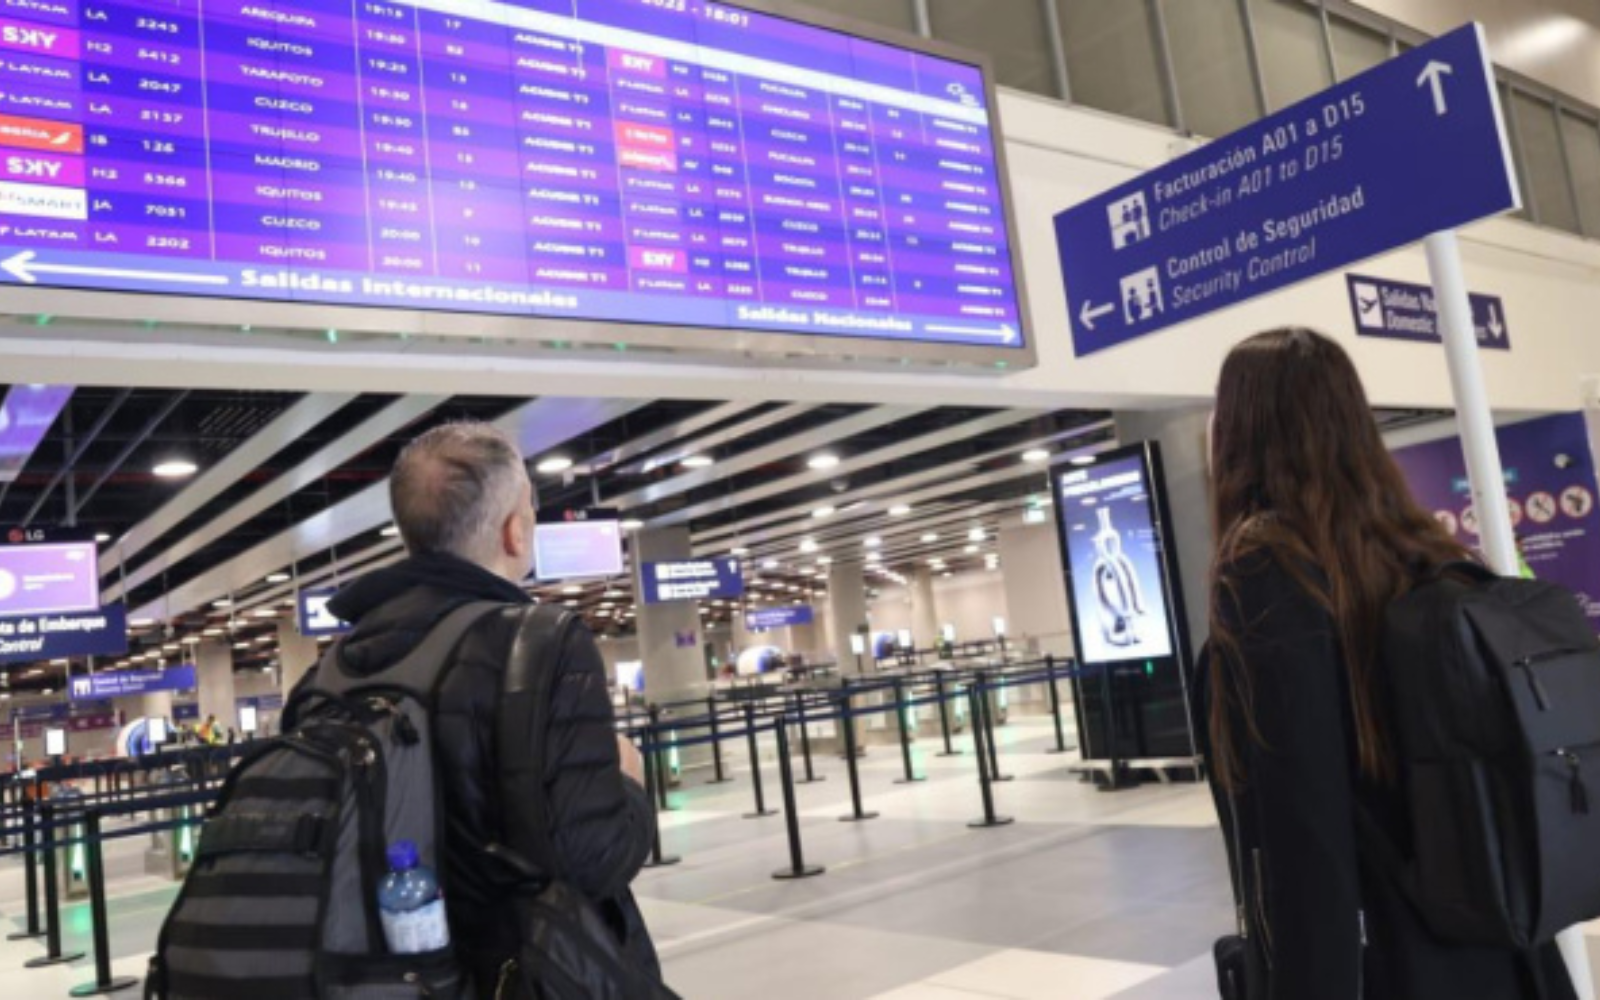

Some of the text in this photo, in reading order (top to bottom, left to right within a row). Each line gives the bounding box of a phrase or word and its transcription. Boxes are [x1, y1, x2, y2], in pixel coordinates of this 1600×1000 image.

[86, 9, 107, 20] LA
[247, 37, 313, 56] IQUITOS
[241, 6, 316, 27] AREQUIPA
[705, 6, 749, 27] 18:01
[3, 26, 57, 48] SKY
[87, 40, 113, 53] H2
[239, 64, 324, 87] TARAPOTO
[8, 63, 72, 79] LATAM
[88, 72, 110, 84] LA
[139, 78, 182, 93] 2047
[254, 96, 313, 114] CUZCO
[9, 94, 72, 109] LATAM
[90, 103, 112, 114] LA
[251, 123, 320, 143] TRUJILLO
[0, 126, 50, 139] BERIA
[90, 134, 108, 146] IB
[254, 154, 320, 172] MADRID
[377, 169, 416, 183] 19:40
[1154, 92, 1365, 202] Facturación A01 a D15
[6, 157, 62, 178] SKY
[93, 167, 118, 180] H2
[256, 185, 322, 202] IQUITOS
[1159, 134, 1344, 231] Check-in A01 to D15
[93, 199, 113, 211] JA
[261, 215, 321, 231] CUZCO
[1167, 185, 1365, 279] Control de Seguridad
[14, 226, 78, 240] LATAM
[95, 231, 118, 243] LA
[260, 245, 326, 261] IQUITOS
[241, 269, 578, 309] Salidas Internacionales
[1173, 236, 1316, 309] Security Control
[738, 306, 913, 331] Salidas Nacionales
[25, 529, 46, 541] LG
[17, 618, 36, 634] de
[38, 615, 107, 633] Embarque
